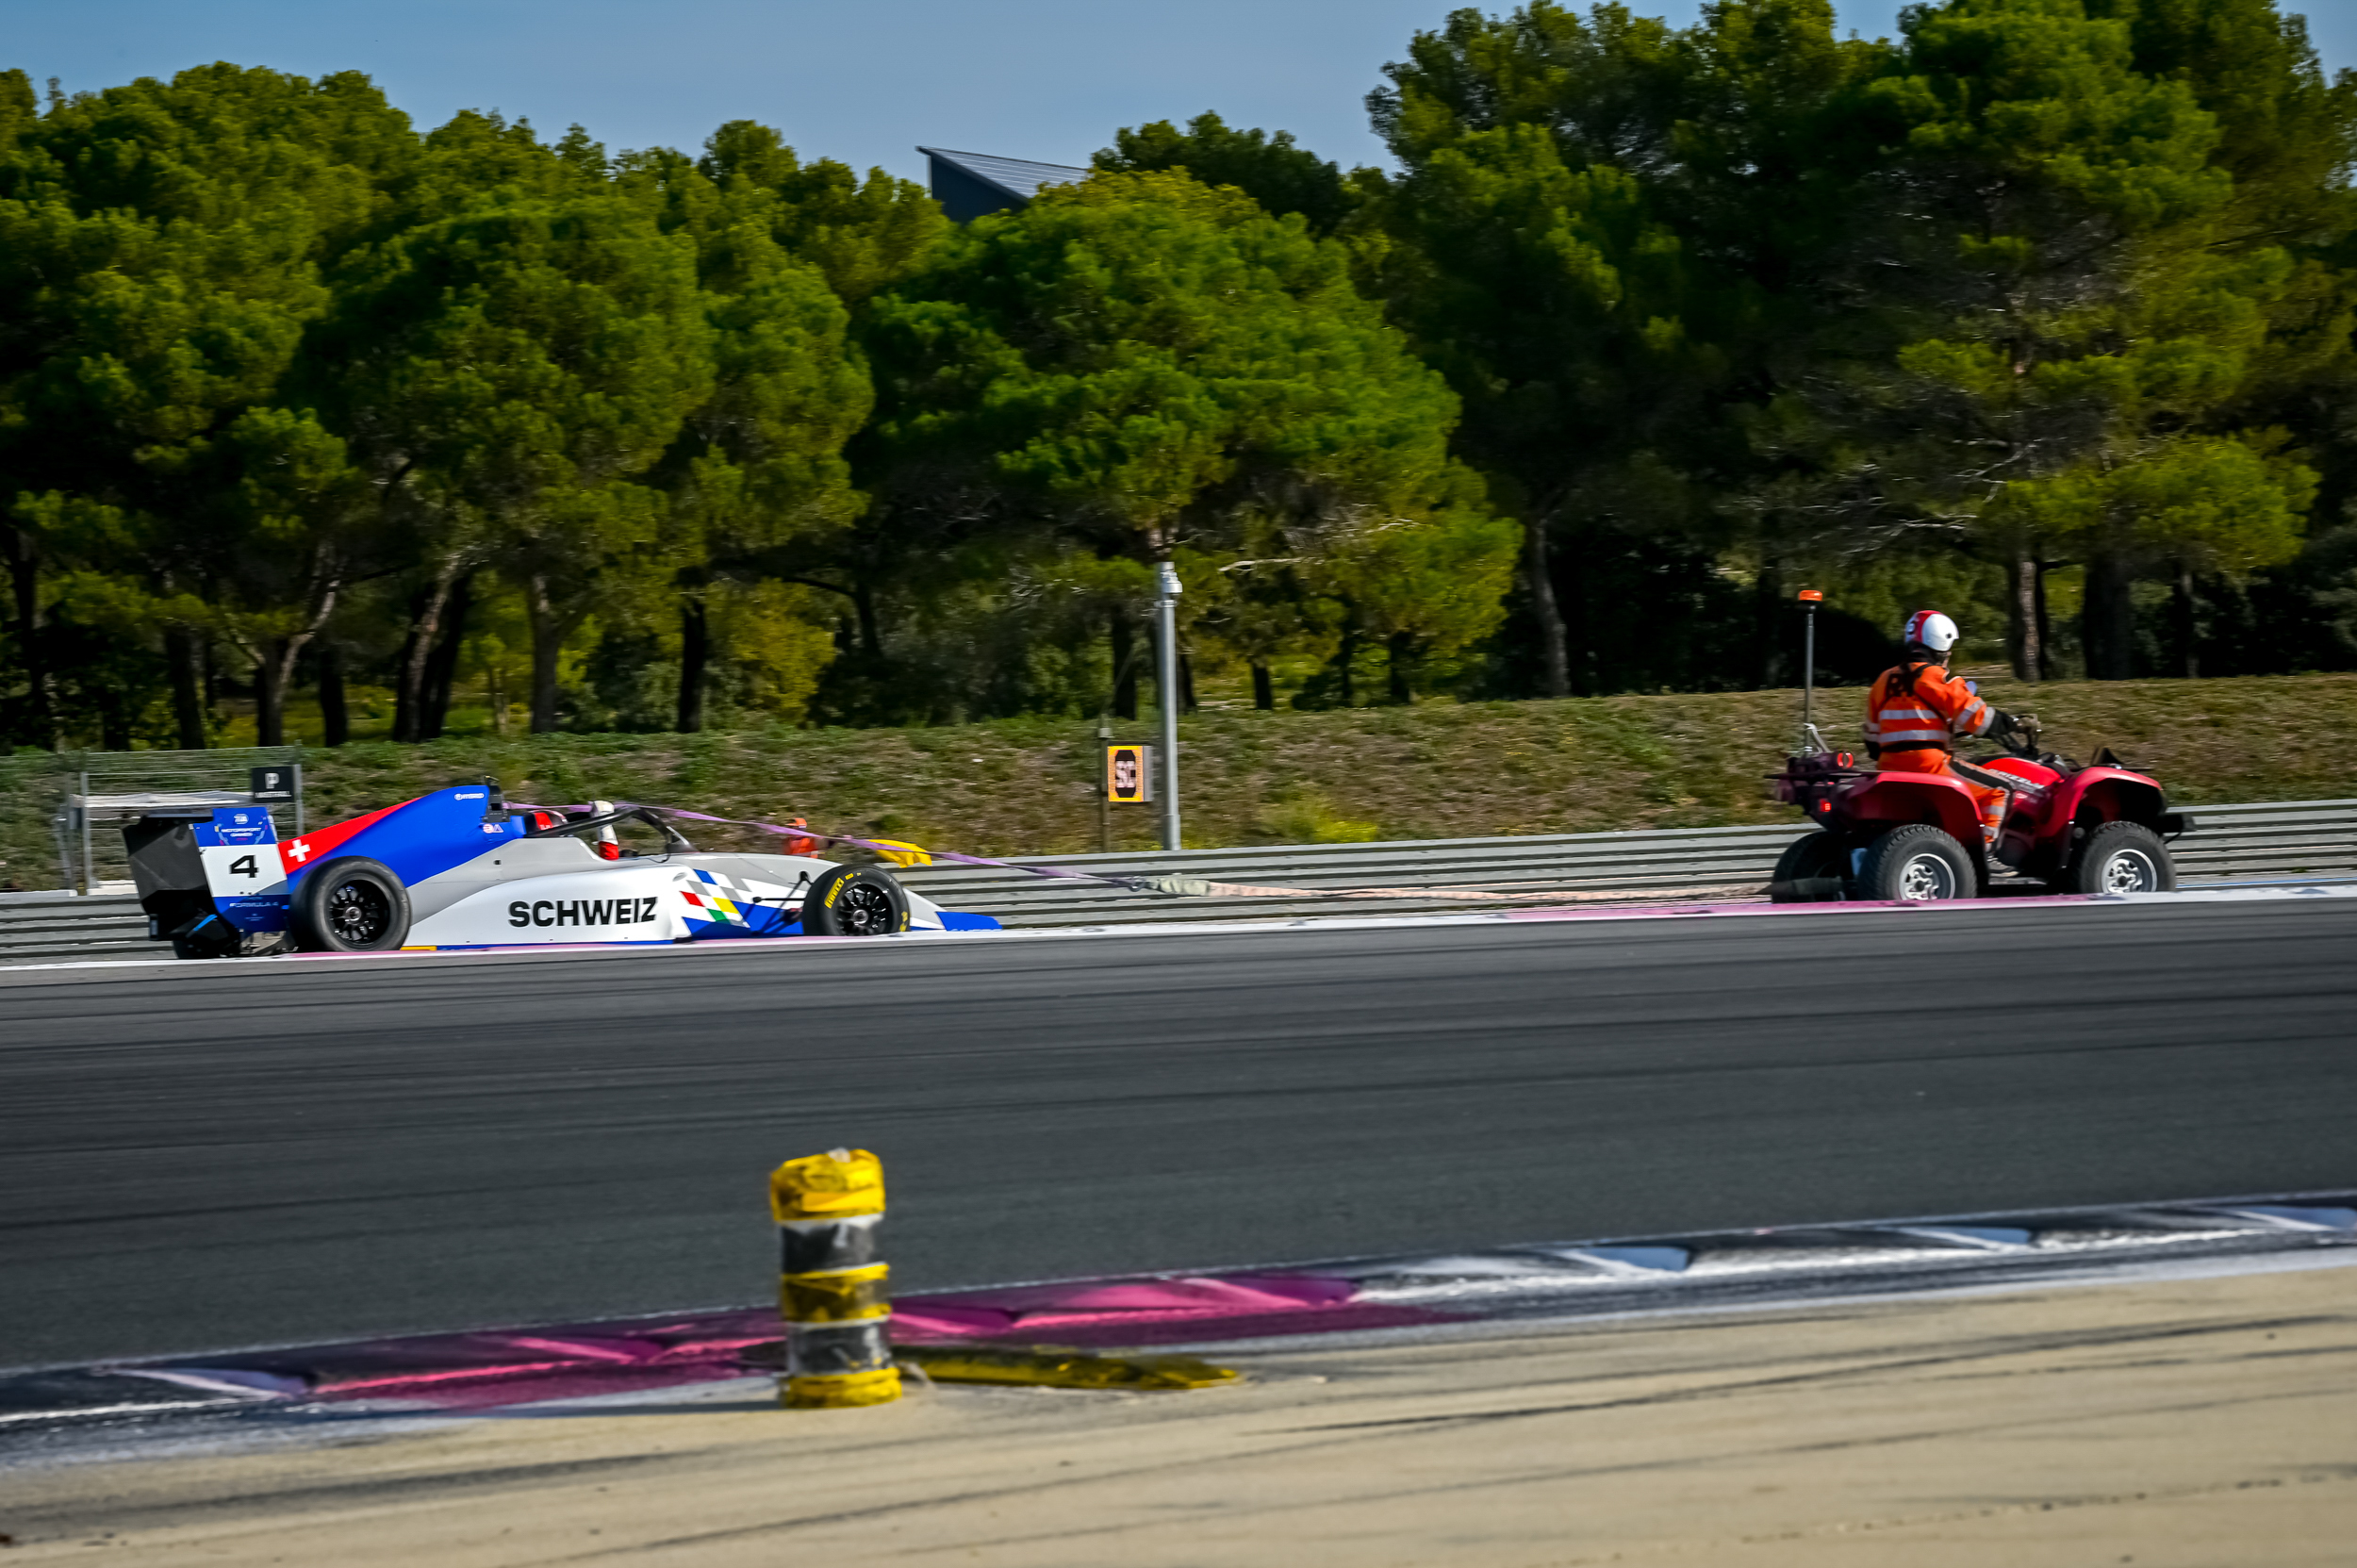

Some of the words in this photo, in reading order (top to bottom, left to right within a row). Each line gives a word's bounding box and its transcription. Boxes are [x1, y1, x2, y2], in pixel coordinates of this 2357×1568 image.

[264, 772, 280, 789] P
[229, 854, 259, 879] 4
[507, 896, 658, 928] SCHWEIZ
